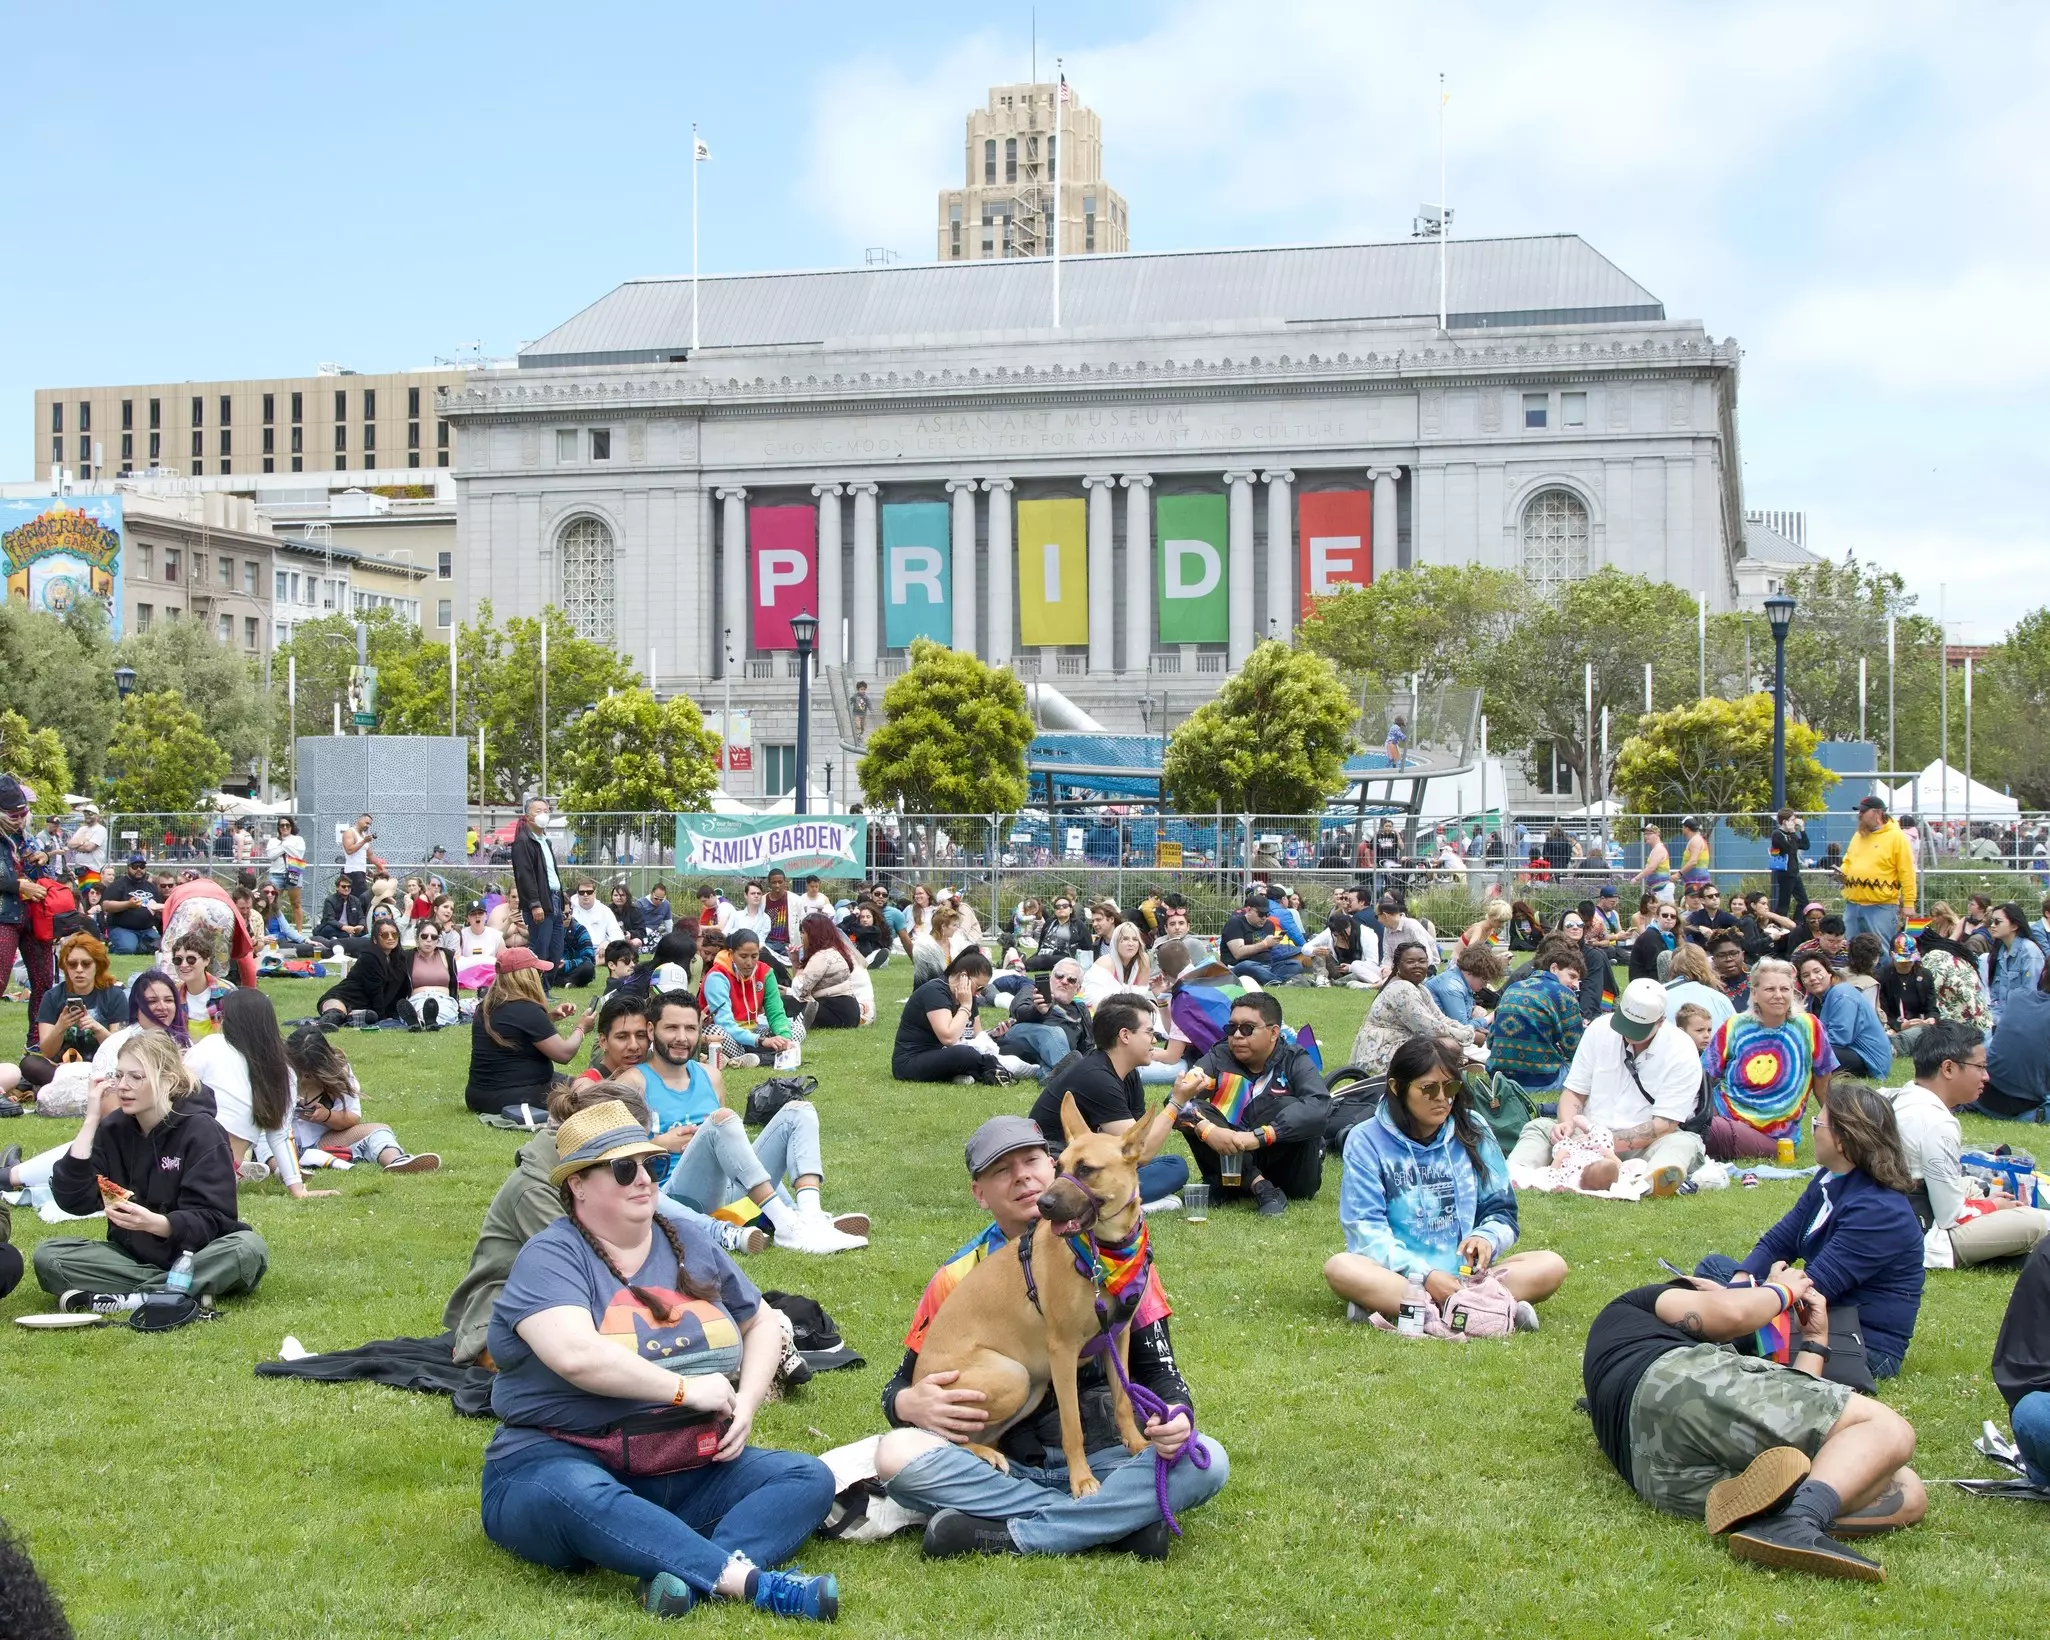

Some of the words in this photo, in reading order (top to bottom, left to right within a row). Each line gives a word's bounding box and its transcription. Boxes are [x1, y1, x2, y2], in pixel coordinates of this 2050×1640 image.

[916, 414, 990, 433] ASIAN
[1003, 413, 1052, 432] ART
[1064, 408, 1185, 427] MUSEUM
[763, 438, 904, 457] CHONG-MOON
[917, 436, 946, 451] LEE
[955, 434, 1032, 450] CENTER
[1041, 433, 1076, 447] FOR
[1087, 430, 1146, 445] ASIAN
[1154, 428, 1191, 443] ART
[1200, 426, 1243, 441] AND
[1252, 423, 1347, 440] CULTURE
[5, 518, 117, 552] TENDERLOIN
[63, 535, 105, 559] GARDEN
[702, 835, 763, 864] FAMILY
[769, 825, 842, 856] GARDEN
[1393, 1170, 1414, 1187] SAN
